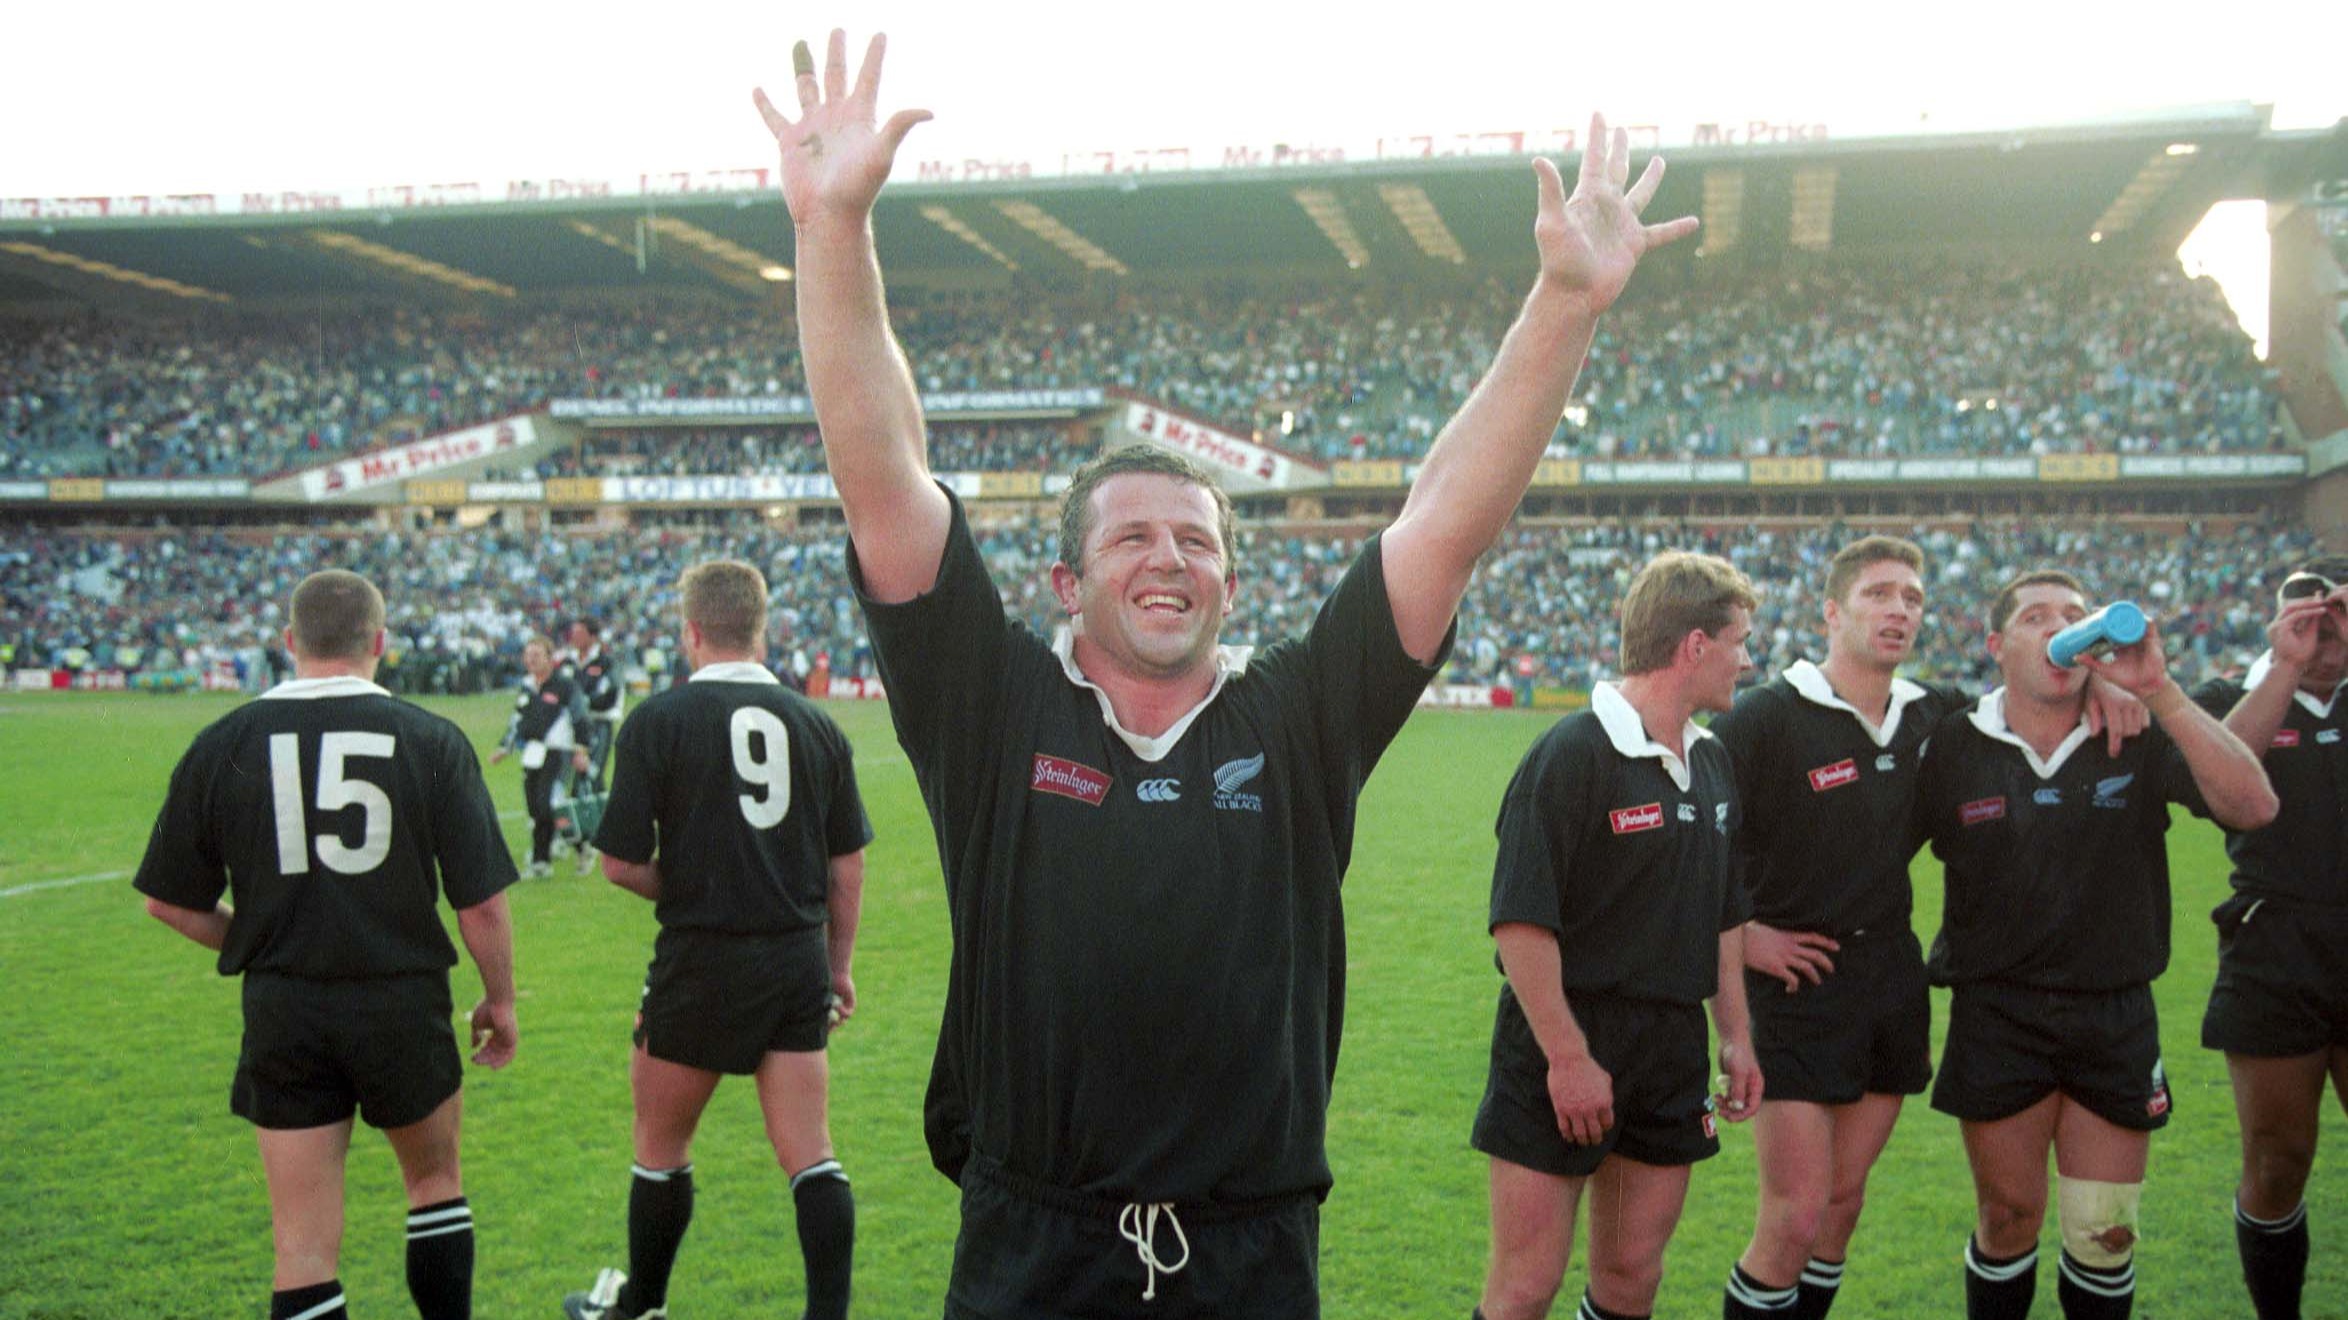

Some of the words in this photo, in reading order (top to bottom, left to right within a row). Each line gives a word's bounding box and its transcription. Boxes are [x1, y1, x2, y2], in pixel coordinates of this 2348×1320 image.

[406, 439, 480, 469] Price
[1195, 430, 1247, 469] Price
[730, 705, 791, 829] 9
[1033, 758, 1102, 796] Steinlager
[268, 731, 396, 875] 15
